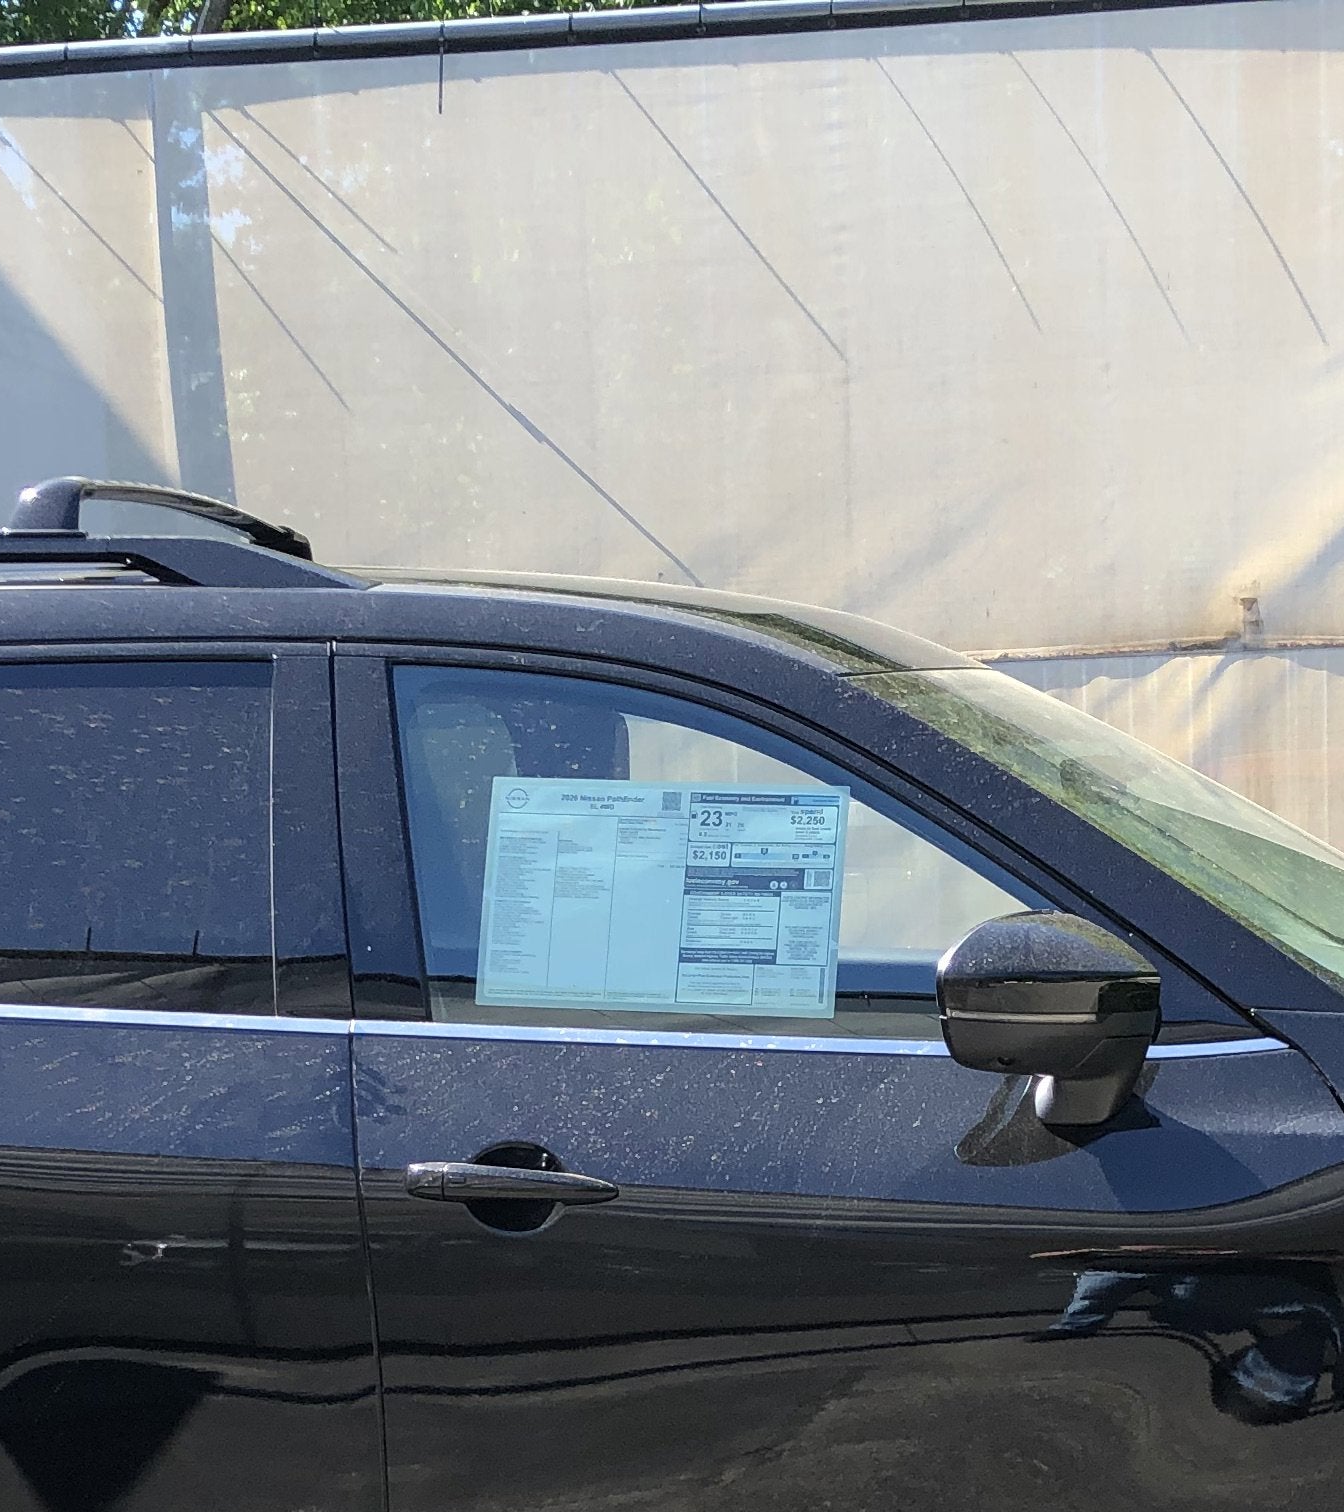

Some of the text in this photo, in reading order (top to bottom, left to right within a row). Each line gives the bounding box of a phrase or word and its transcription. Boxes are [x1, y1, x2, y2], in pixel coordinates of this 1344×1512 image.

[579, 794, 606, 802] Nissan
[700, 809, 723, 827] 23
[790, 815, 826, 826] $2,250
[692, 850, 727, 861] $2,150
